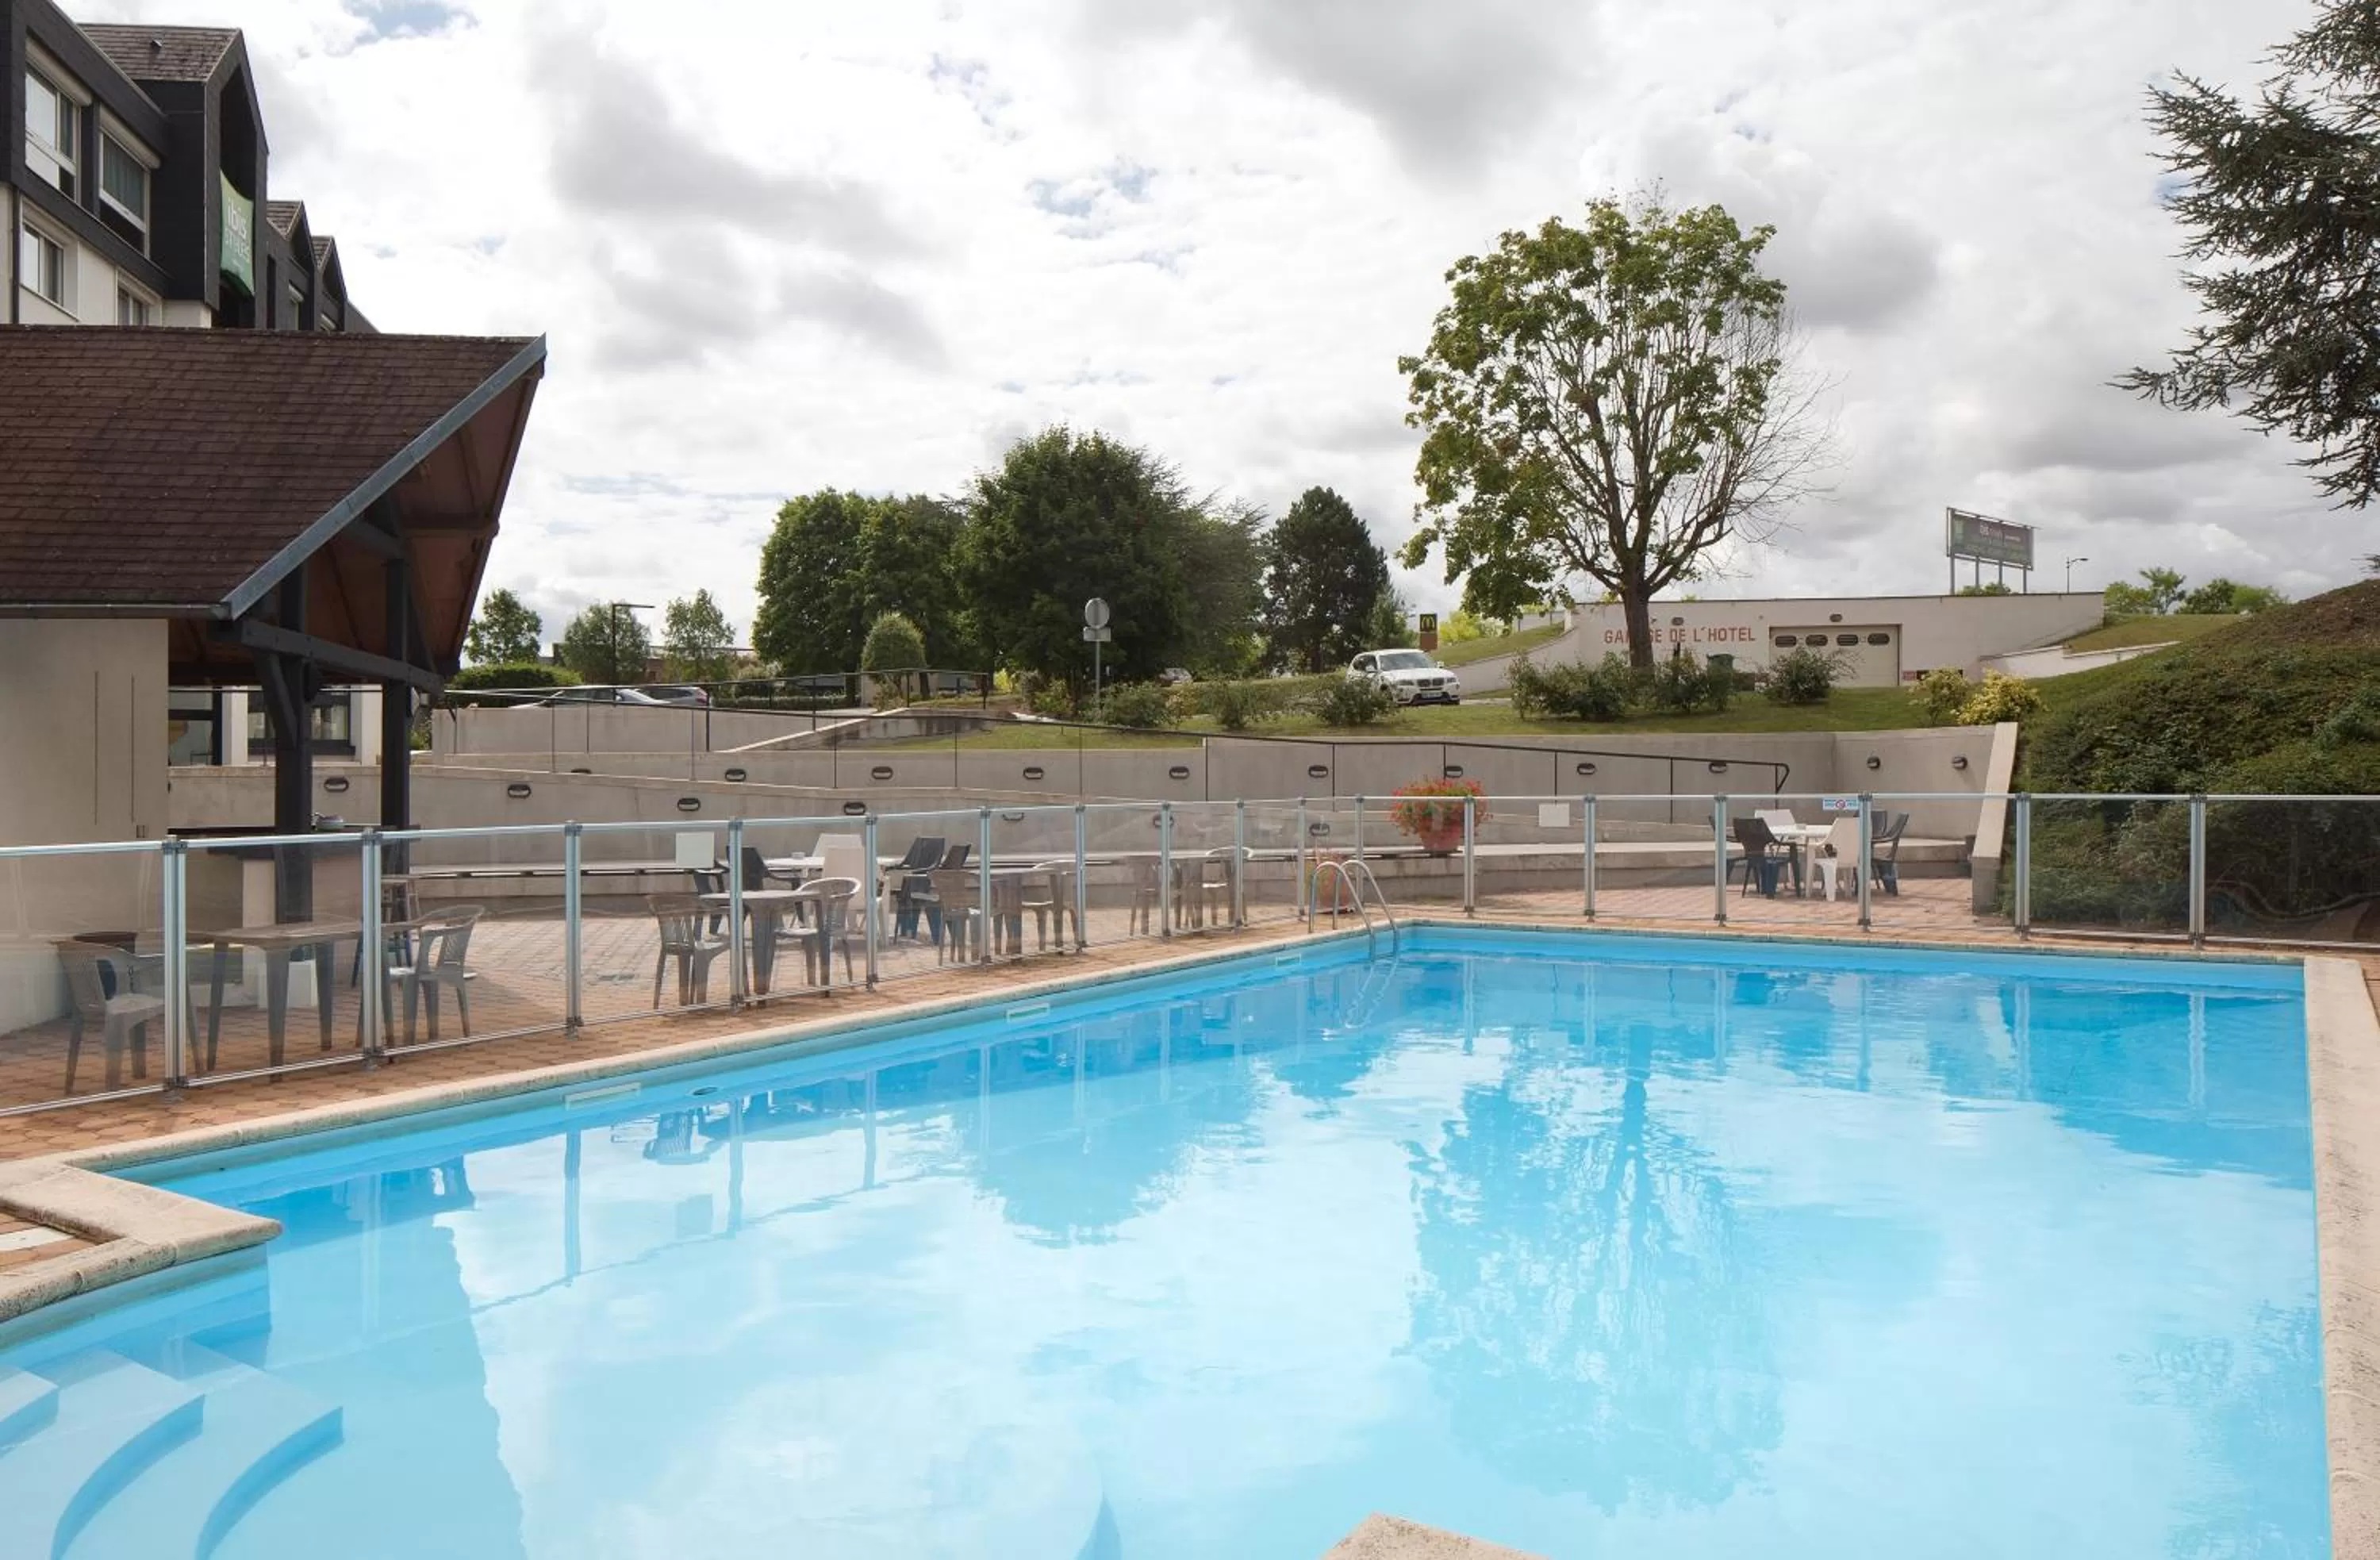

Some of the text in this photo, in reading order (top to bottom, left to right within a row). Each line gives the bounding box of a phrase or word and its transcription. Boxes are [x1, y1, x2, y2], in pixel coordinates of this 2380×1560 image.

[227, 197, 248, 240] ibis
[1604, 628, 1662, 644] GAGE
[1670, 628, 1686, 643] DE
